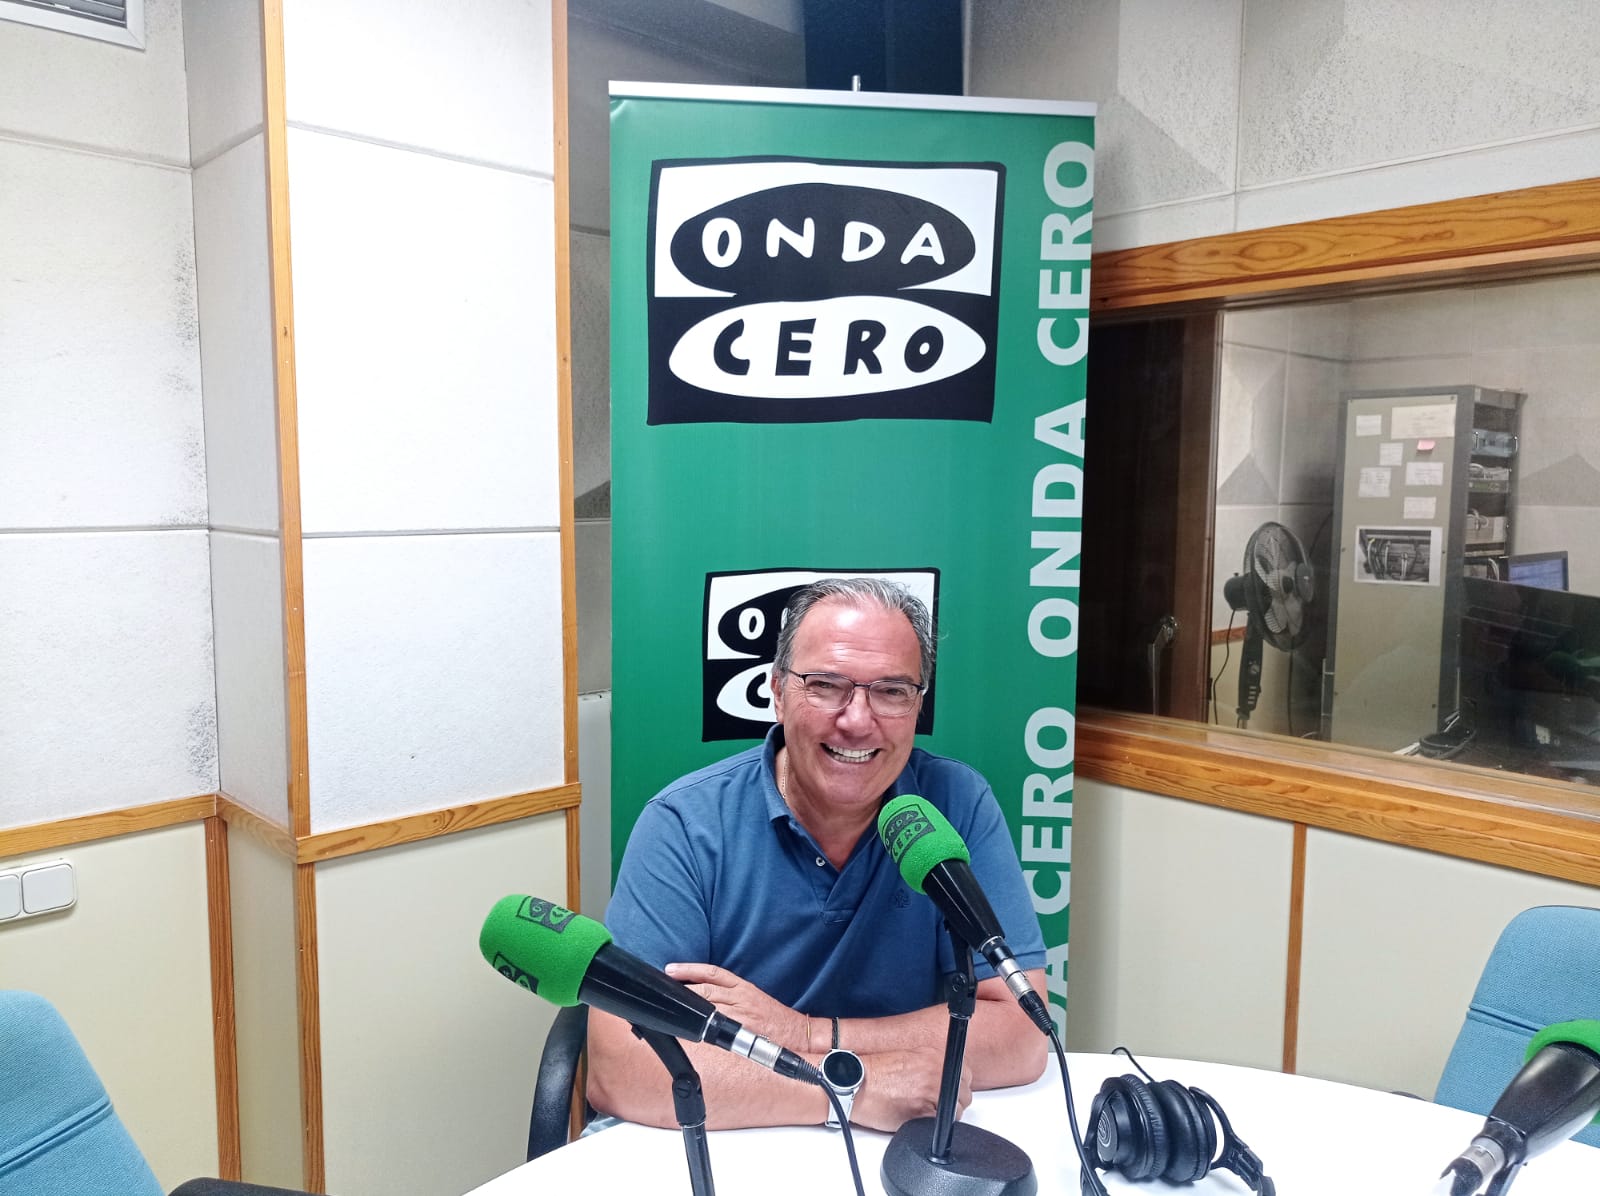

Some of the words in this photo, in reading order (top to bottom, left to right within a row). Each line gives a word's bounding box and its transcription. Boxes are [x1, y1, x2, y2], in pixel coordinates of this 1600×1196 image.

[701, 216, 945, 268] ONDA
[1036, 140, 1096, 366] CERO
[713, 318, 944, 376] CERO
[1027, 398, 1087, 658] ONDA
[1021, 706, 1076, 915] CERO
